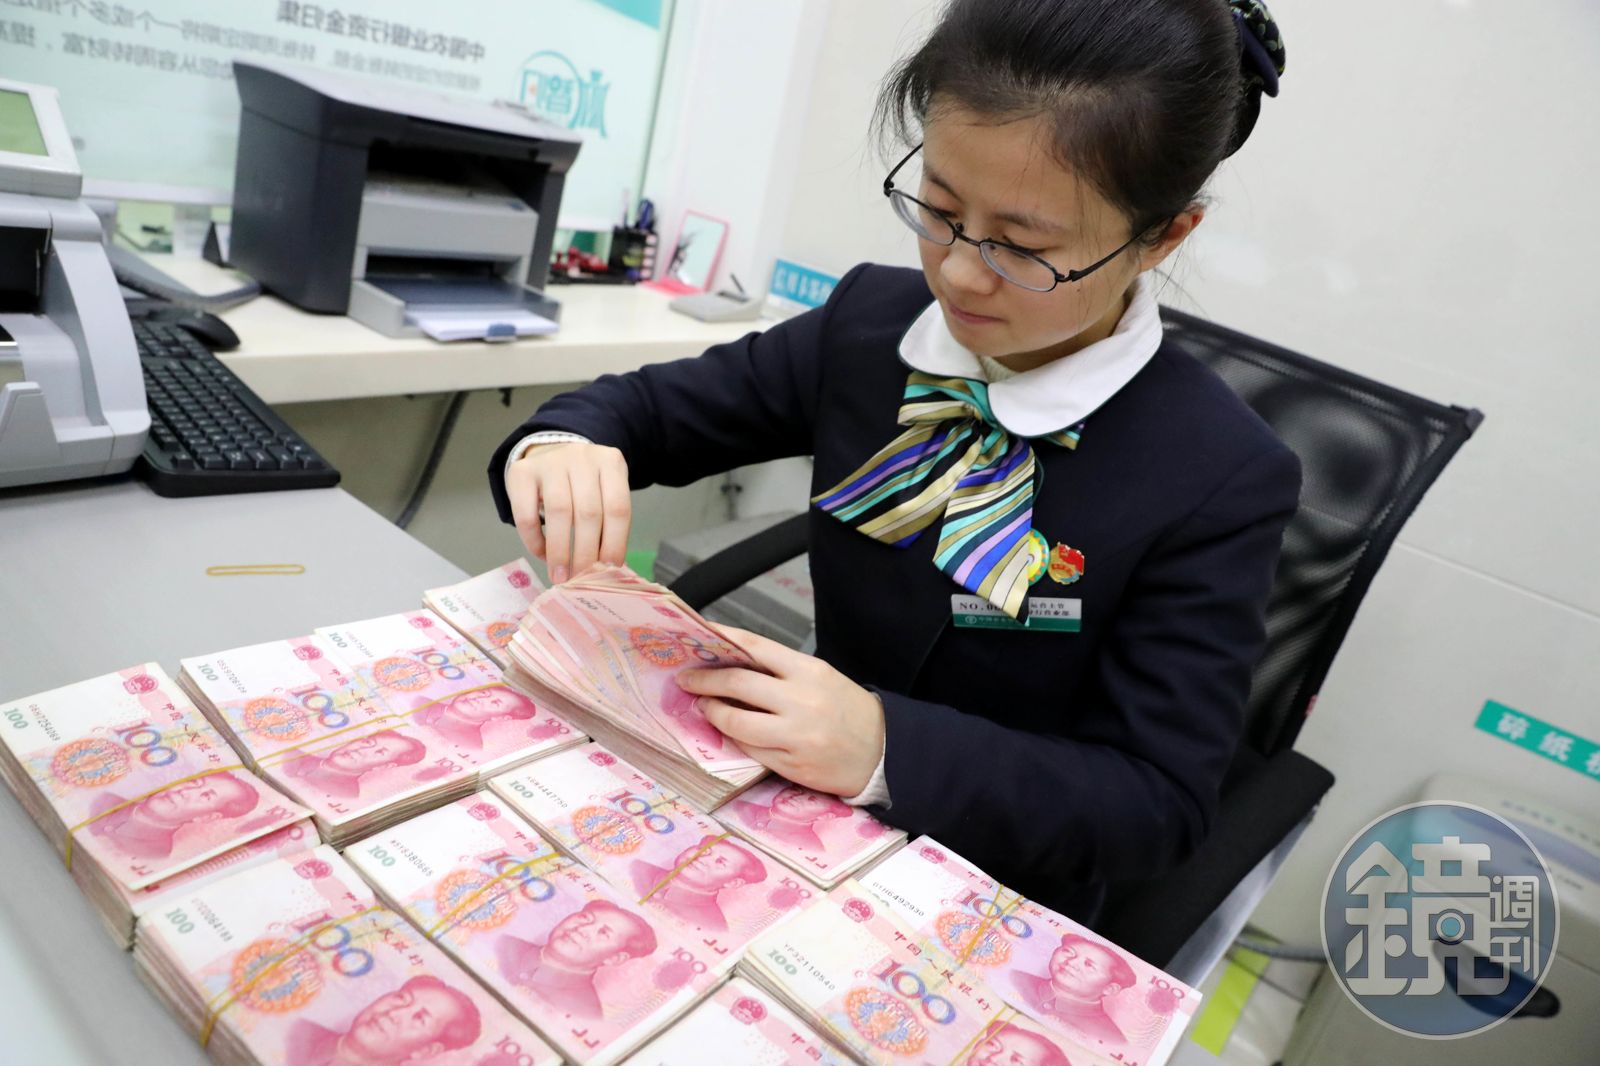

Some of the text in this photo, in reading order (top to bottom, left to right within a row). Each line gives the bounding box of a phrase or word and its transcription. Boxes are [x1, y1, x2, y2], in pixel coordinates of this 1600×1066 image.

[328, 632, 349, 650] 100
[198, 663, 220, 682] 100
[413, 647, 465, 680] 100
[292, 684, 350, 729] 100
[3, 708, 30, 731] 100
[544, 717, 571, 736] 100
[114, 720, 178, 768] 100
[435, 757, 464, 774] 100
[509, 780, 536, 800] 100
[609, 790, 676, 835] 100
[367, 845, 396, 868] 100
[780, 877, 812, 899] 100
[165, 907, 196, 935] 100
[672, 947, 708, 975] 100
[767, 949, 798, 976] 100
[894, 930, 992, 1012] 中国人民银行
[875, 959, 957, 1026] 100
[1150, 975, 1185, 999] 100
